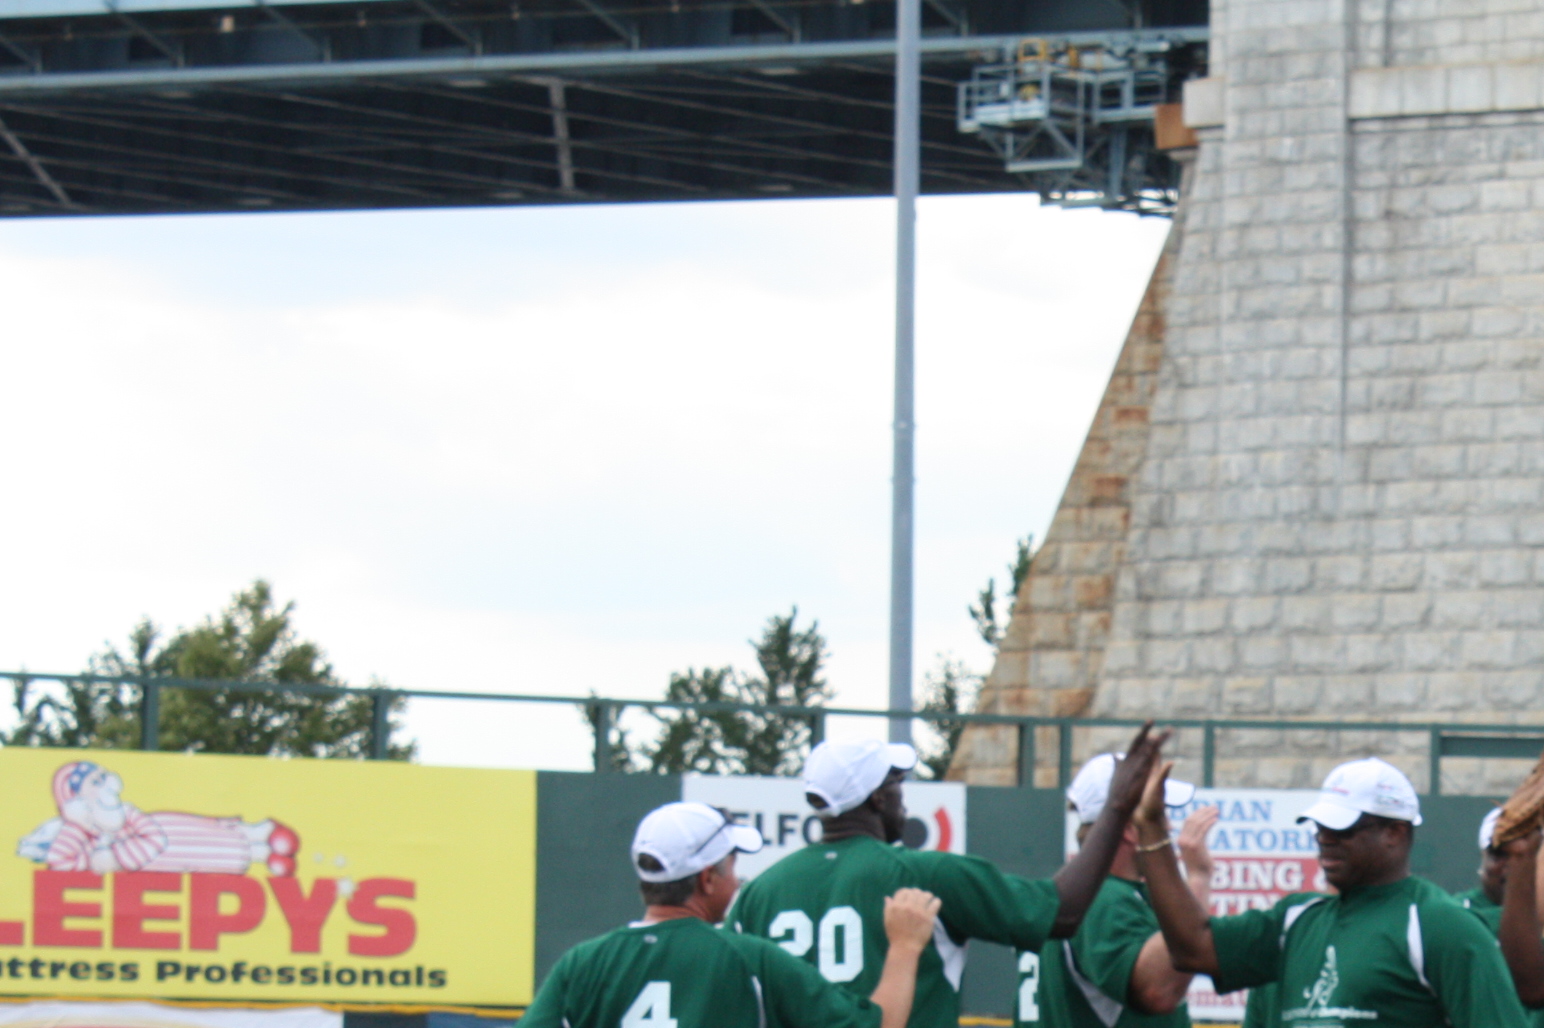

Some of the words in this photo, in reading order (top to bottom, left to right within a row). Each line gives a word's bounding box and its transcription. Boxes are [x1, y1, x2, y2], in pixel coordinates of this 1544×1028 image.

[729, 812, 824, 848] LFO
[769, 905, 864, 983] 20
[0, 956, 140, 983] ttress
[156, 960, 447, 989] Professionals
